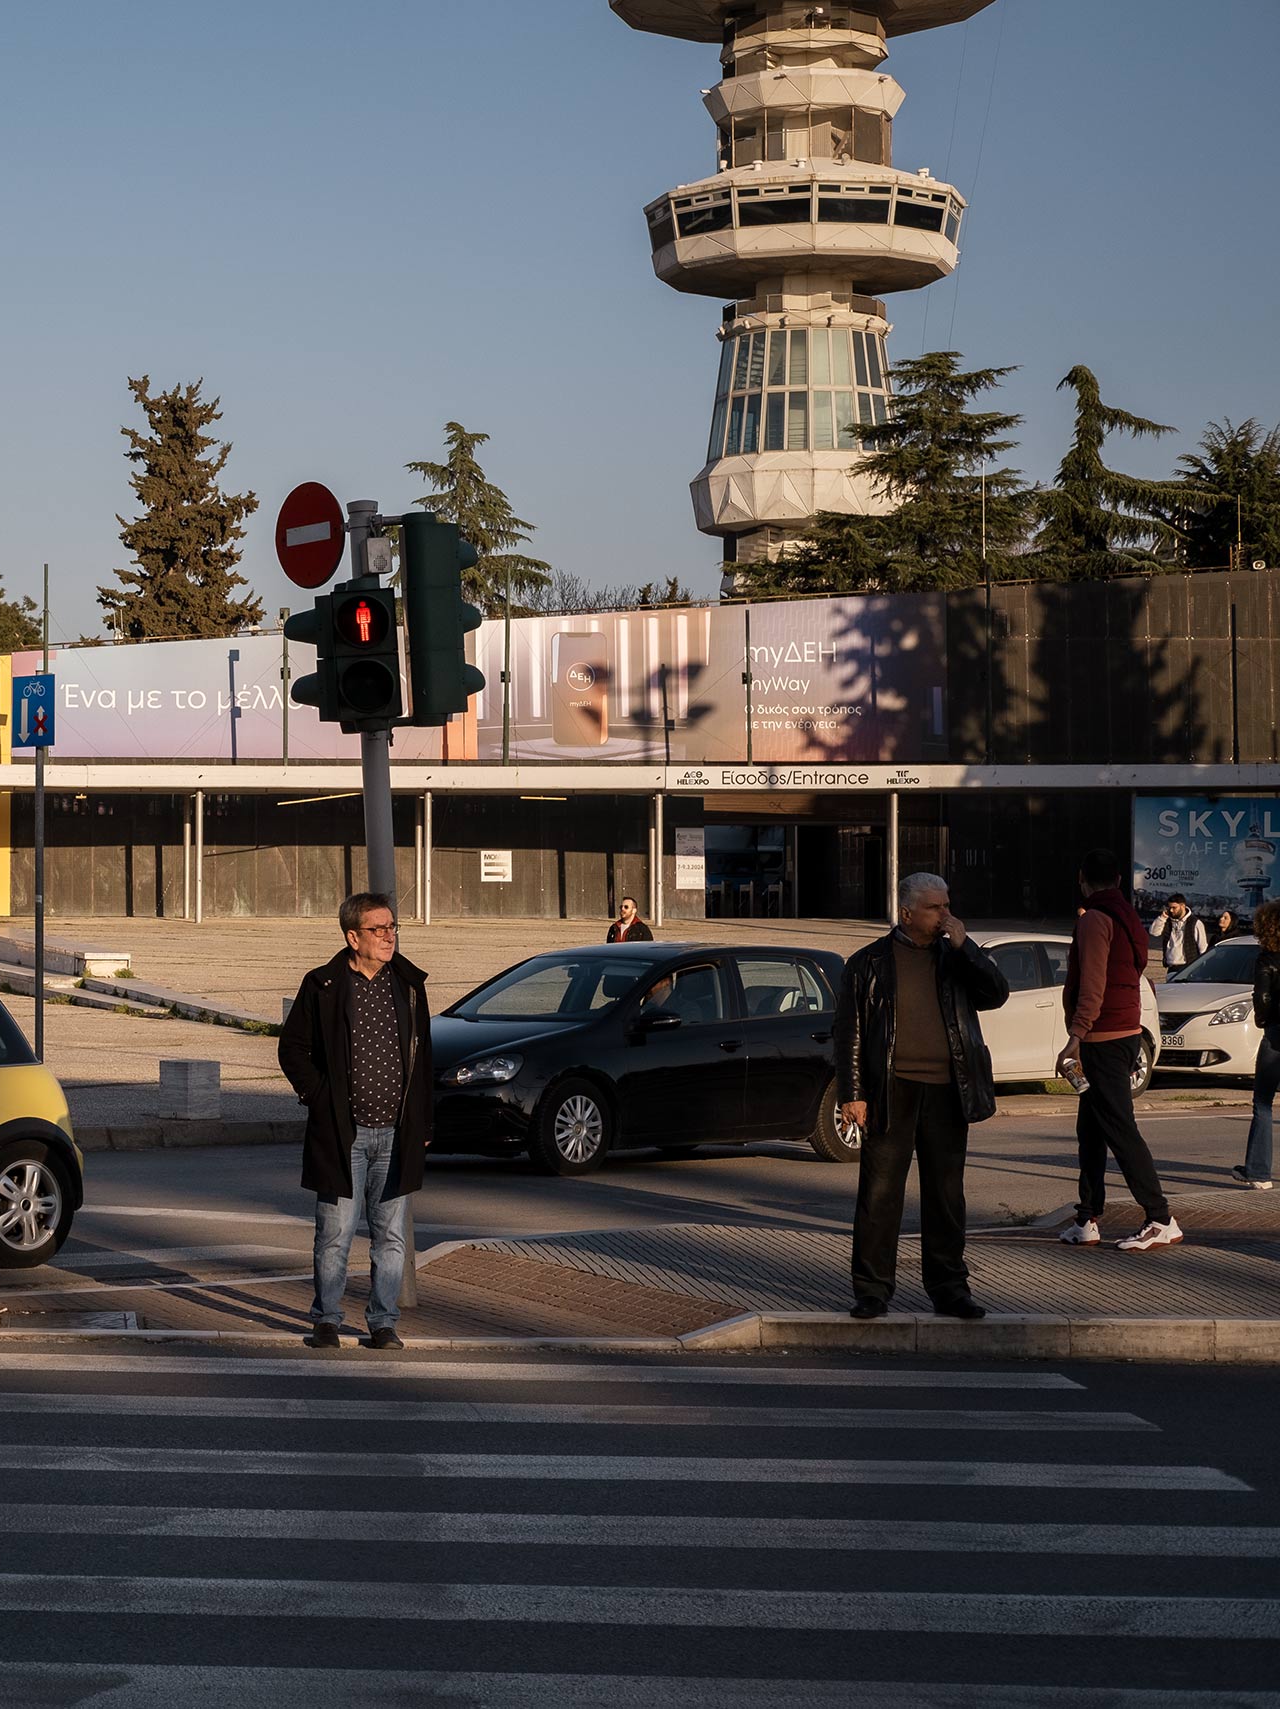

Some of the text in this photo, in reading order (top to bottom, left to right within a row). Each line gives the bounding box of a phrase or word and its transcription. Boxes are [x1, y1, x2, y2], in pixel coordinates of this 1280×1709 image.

[569, 670, 591, 683] ΔΕΗ
[60, 683, 116, 708] Ένα
[128, 689, 162, 715] με
[171, 690, 207, 709] το
[757, 704, 789, 715] δικός
[791, 706, 815, 714] σου
[817, 704, 862, 716] τρόπος
[761, 721, 782, 731] την
[784, 719, 840, 731] ενέργεια.
[1174, 841, 1228, 855] CAFE
